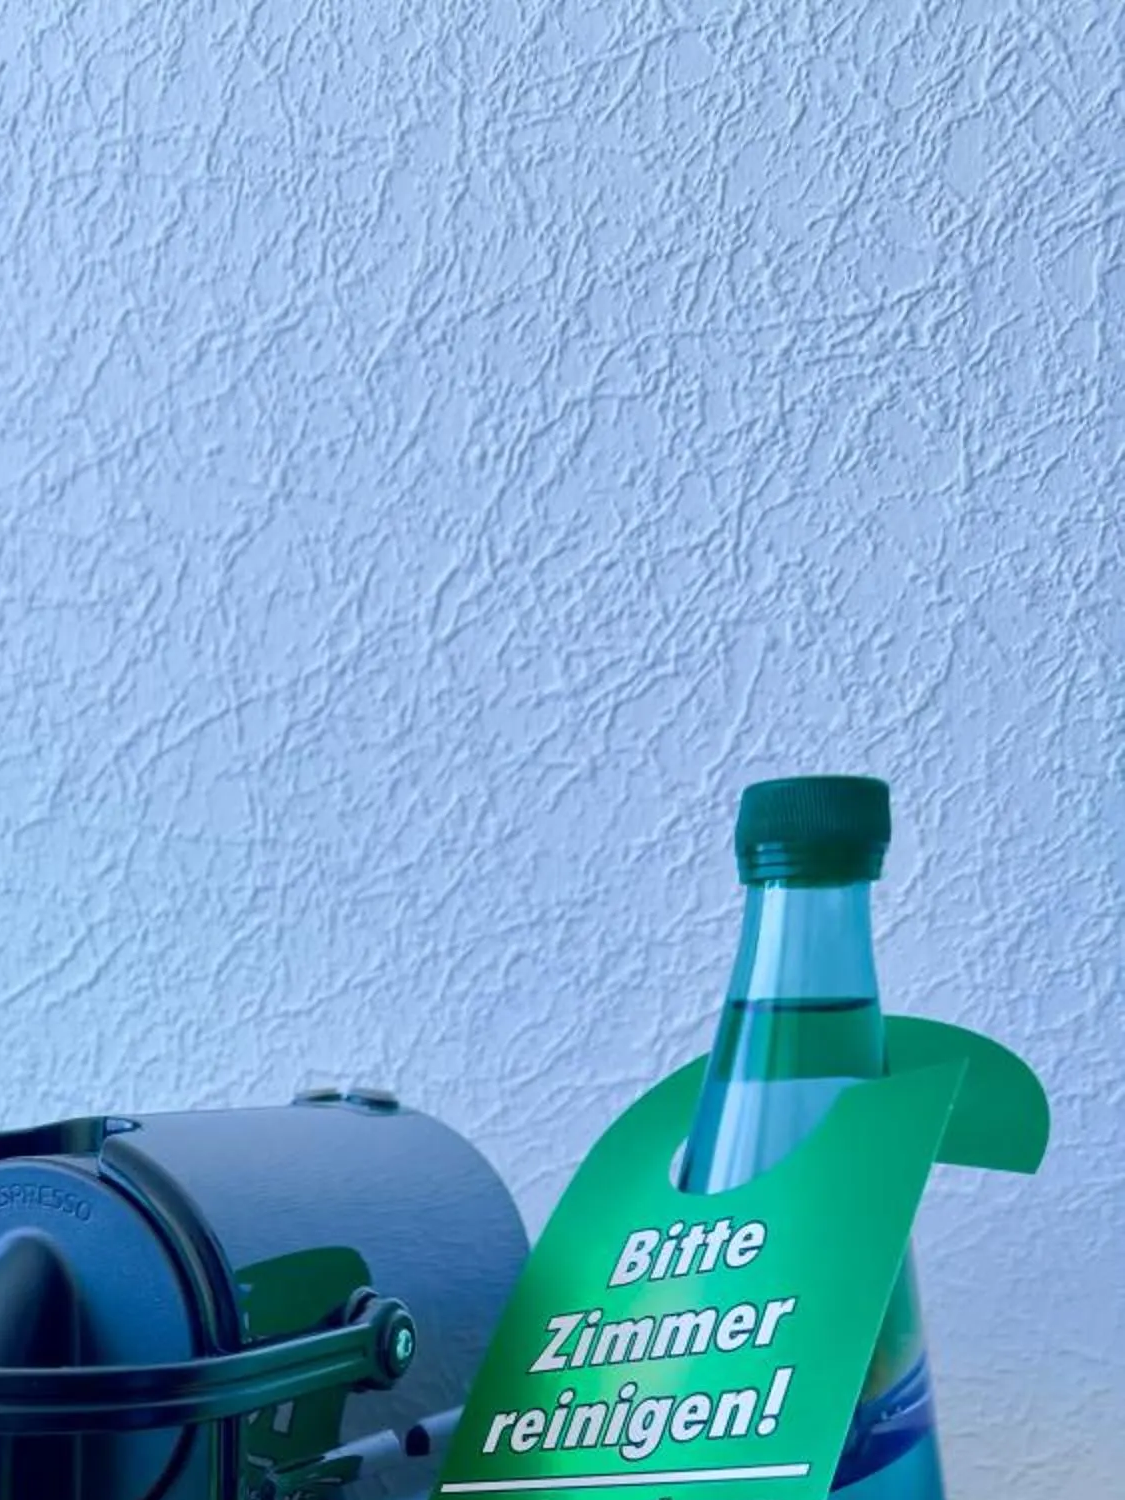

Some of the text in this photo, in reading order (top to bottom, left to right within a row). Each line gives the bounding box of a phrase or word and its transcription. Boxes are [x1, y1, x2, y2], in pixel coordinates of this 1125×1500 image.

[607, 1217, 768, 1288] Bitte
[528, 1295, 799, 1374] Zimmer
[482, 1366, 794, 1461] reinigen!
